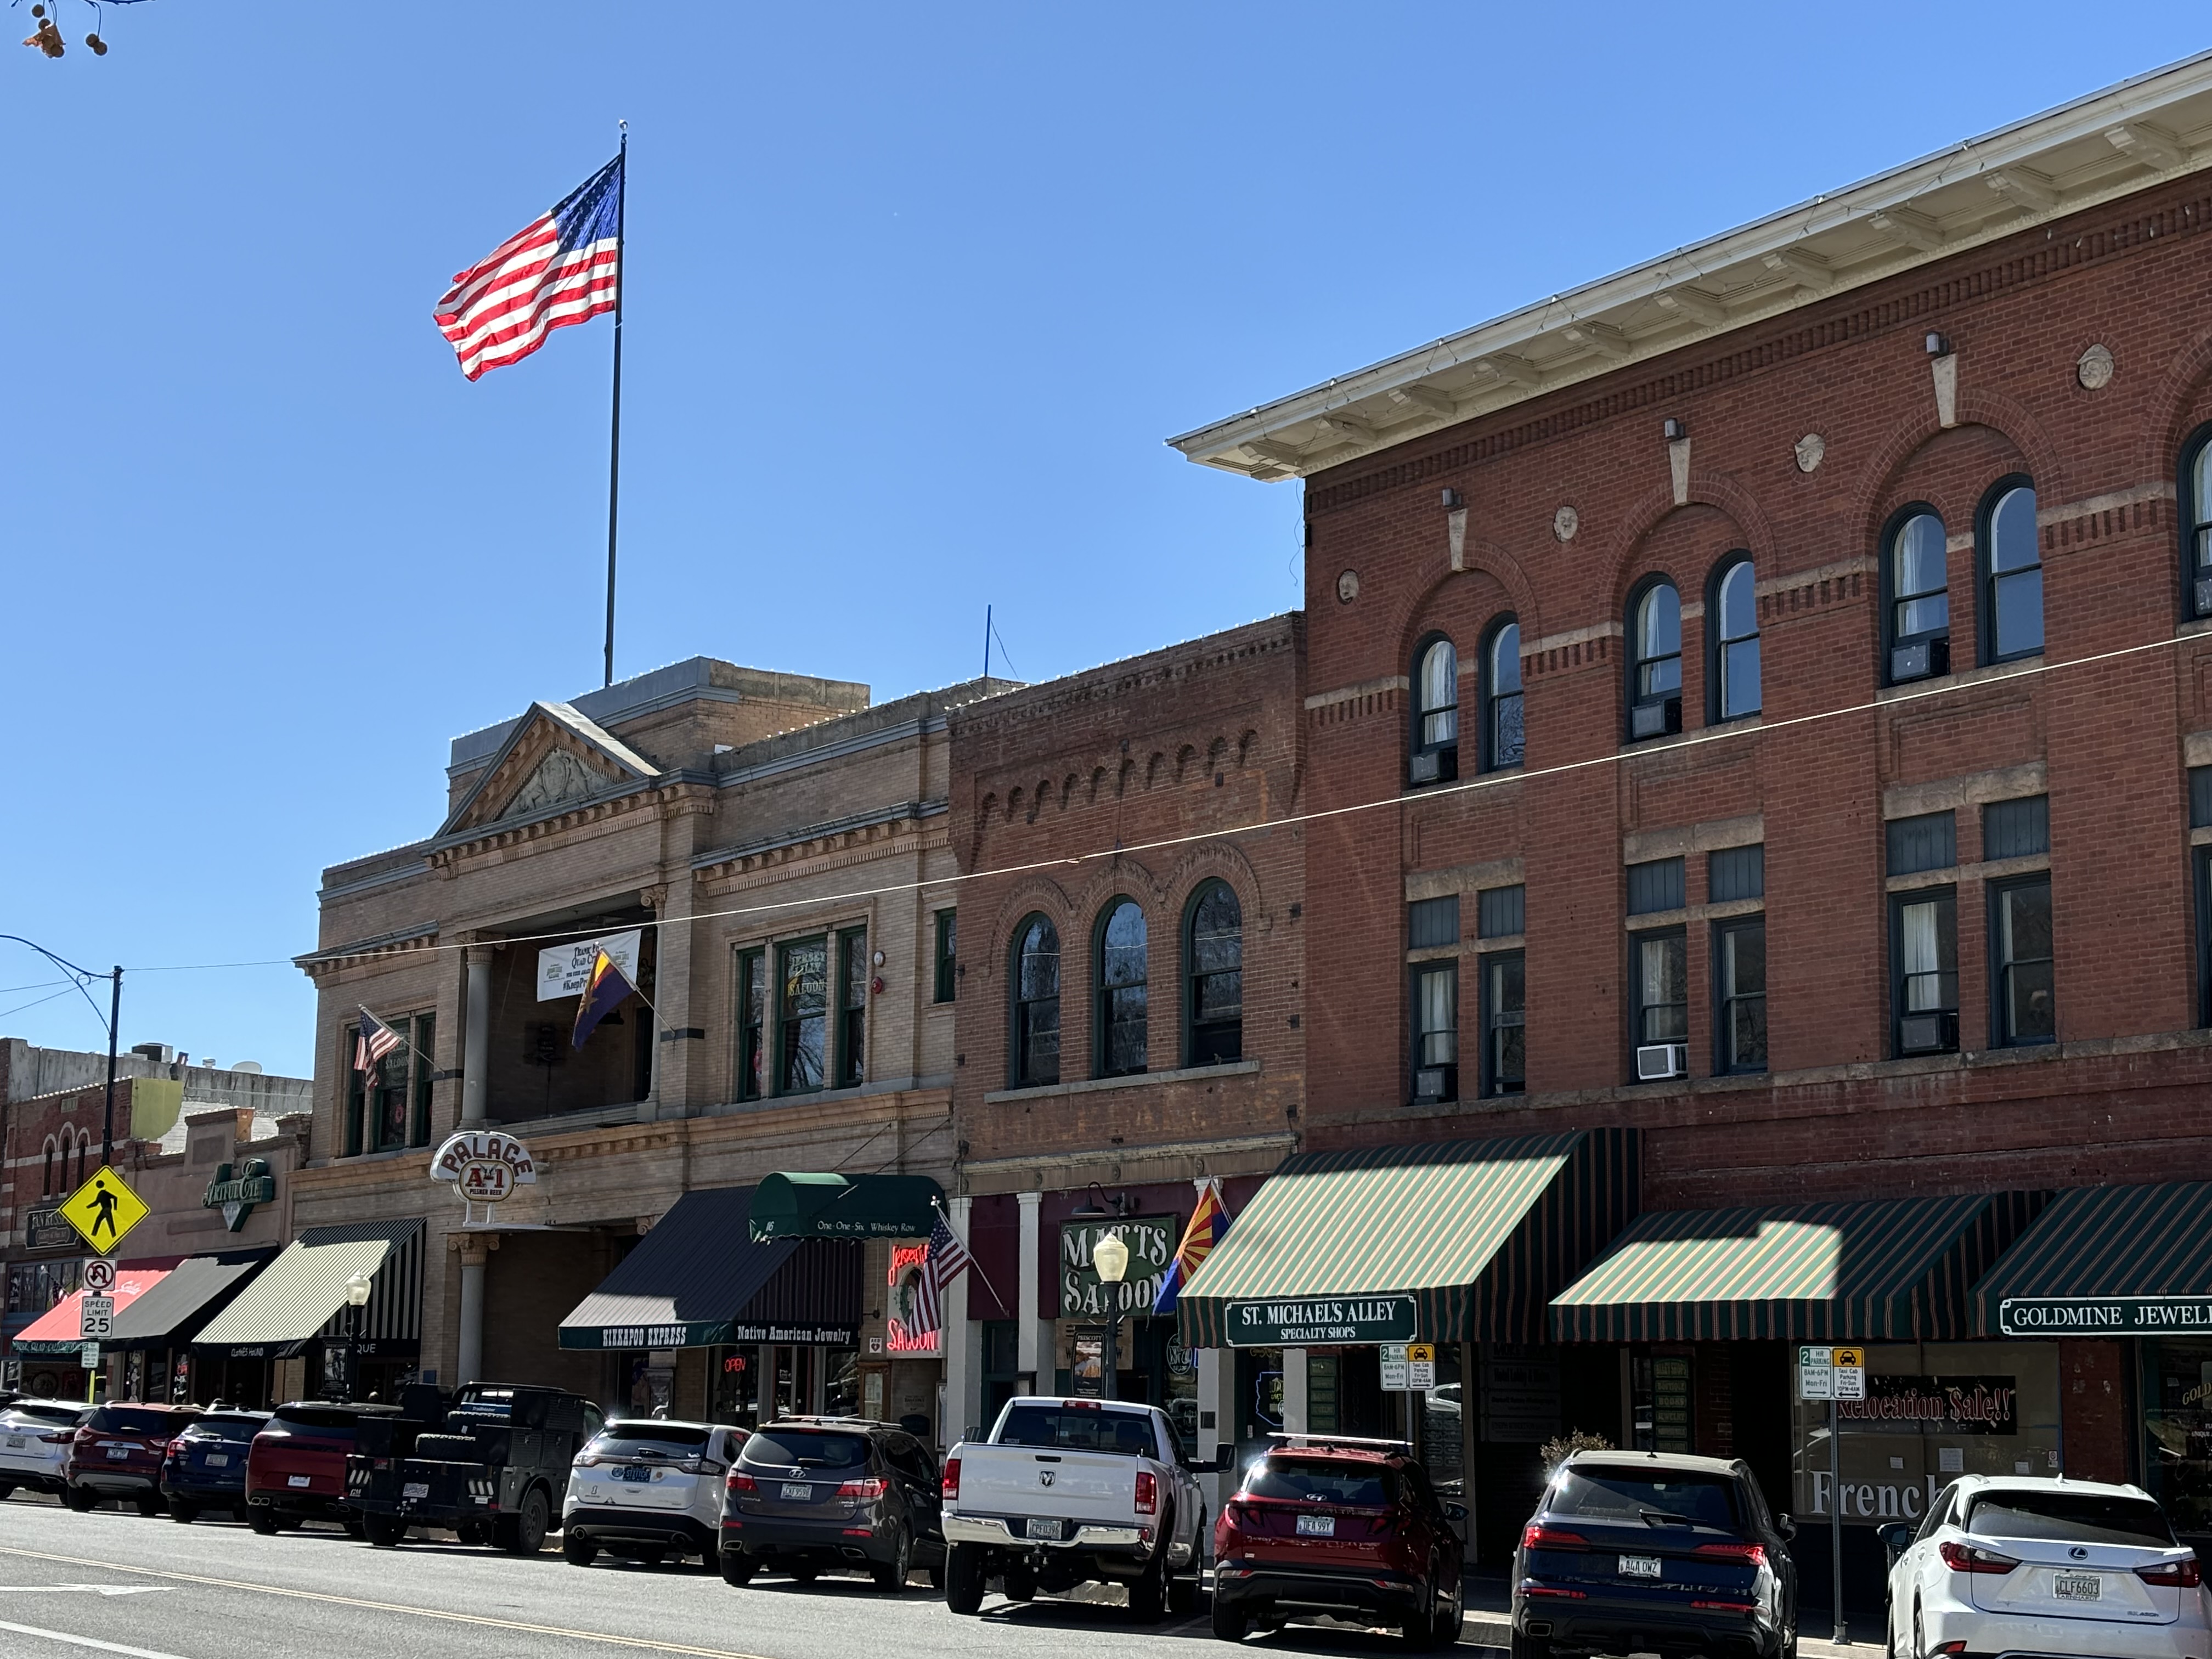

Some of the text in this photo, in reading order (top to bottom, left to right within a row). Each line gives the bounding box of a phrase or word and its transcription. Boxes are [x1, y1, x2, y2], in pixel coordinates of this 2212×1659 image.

[790, 979, 825, 996] SALOON
[441, 1137, 533, 1177] PALACE
[465, 1167, 504, 1188] A-1
[871, 1222, 899, 1235] Whiskey
[901, 1223, 916, 1232] Row
[1242, 1301, 1396, 1325] ST. MICHAEL'S ALLEY
[2014, 1306, 2123, 1326] GOLDMINE
[84, 1318, 109, 1333] 25
[1280, 1326, 1356, 1340] SPECIALTY SHOPS
[647, 1327, 686, 1346] EXPRESS
[737, 1325, 850, 1344] Native American Jewelry
[1383, 1348, 1388, 1359] 2
[1802, 1351, 1809, 1364] 2
[725, 1358, 746, 1372] OPEN
[1659, 1396, 1684, 1406] BOOKS
[1837, 1388, 2010, 1421] Relocation Sale!!
[2059, 1581, 2099, 1594] CLF6603
